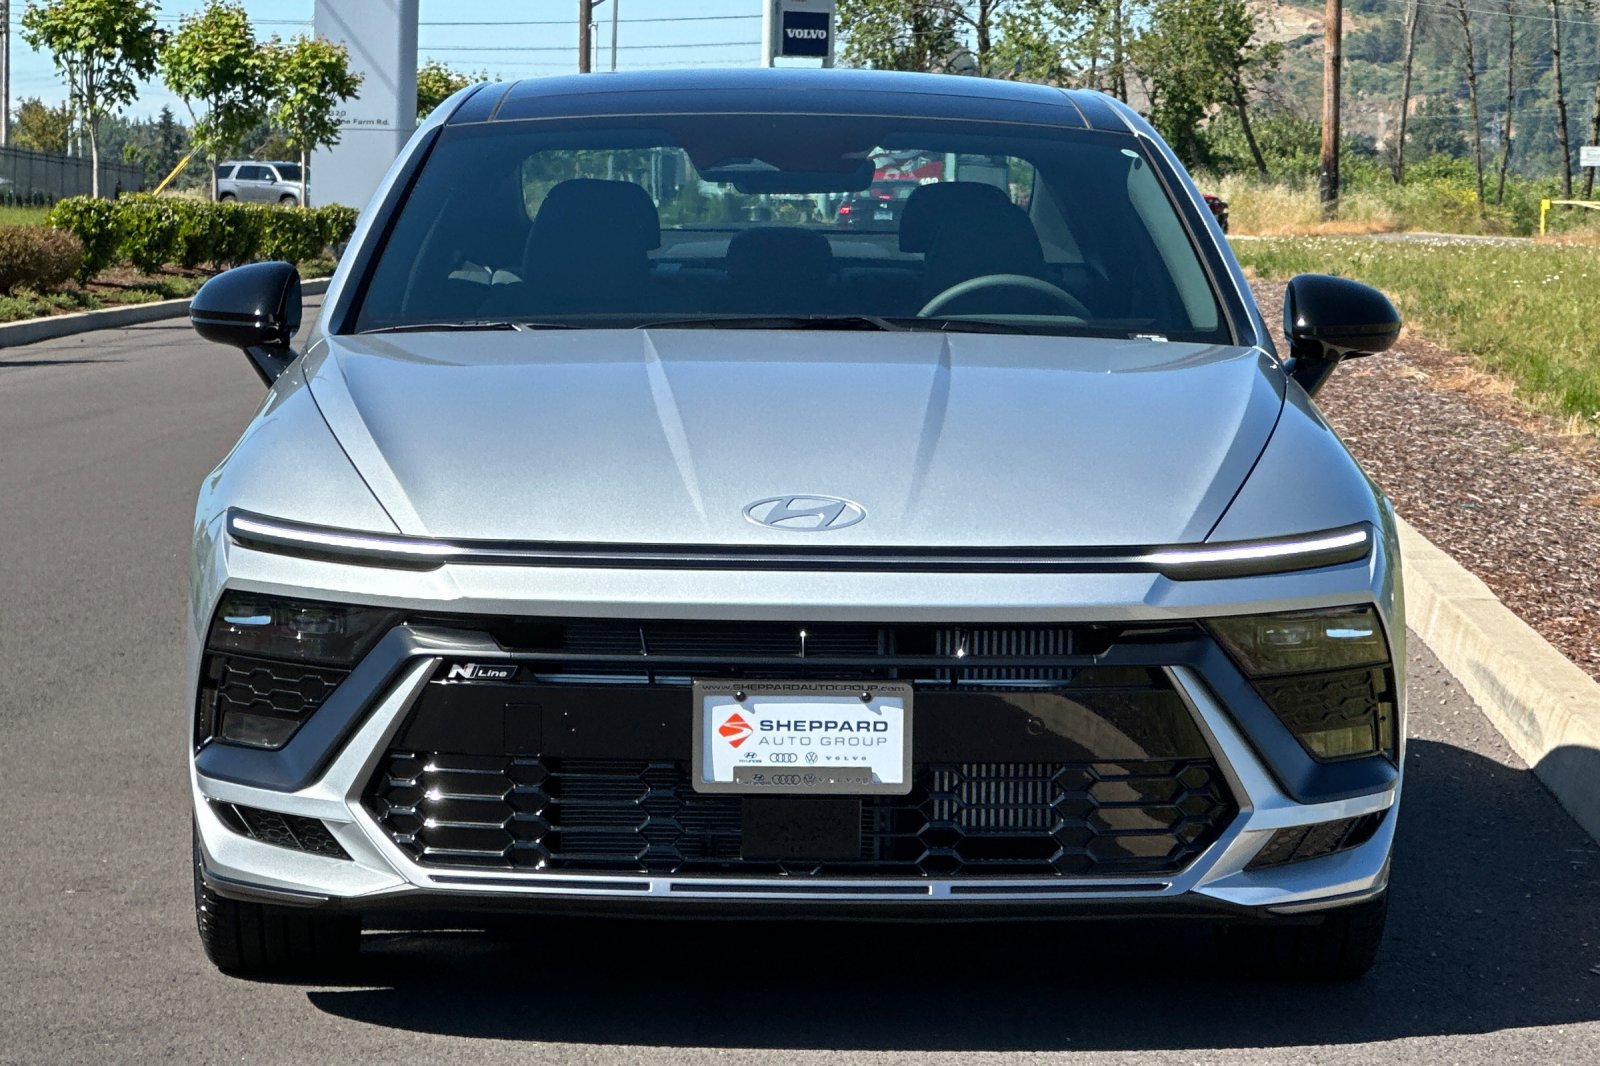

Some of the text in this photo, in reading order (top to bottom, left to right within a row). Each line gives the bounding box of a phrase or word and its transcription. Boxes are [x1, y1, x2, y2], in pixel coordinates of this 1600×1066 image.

[786, 28, 827, 39] VOLVO
[448, 663, 507, 678] N Line
[702, 683, 904, 692] www.SHEPPARDAUTOGROUP.com
[760, 720, 888, 732] SHEPPARD
[758, 736, 887, 746] AUTO GROUP
